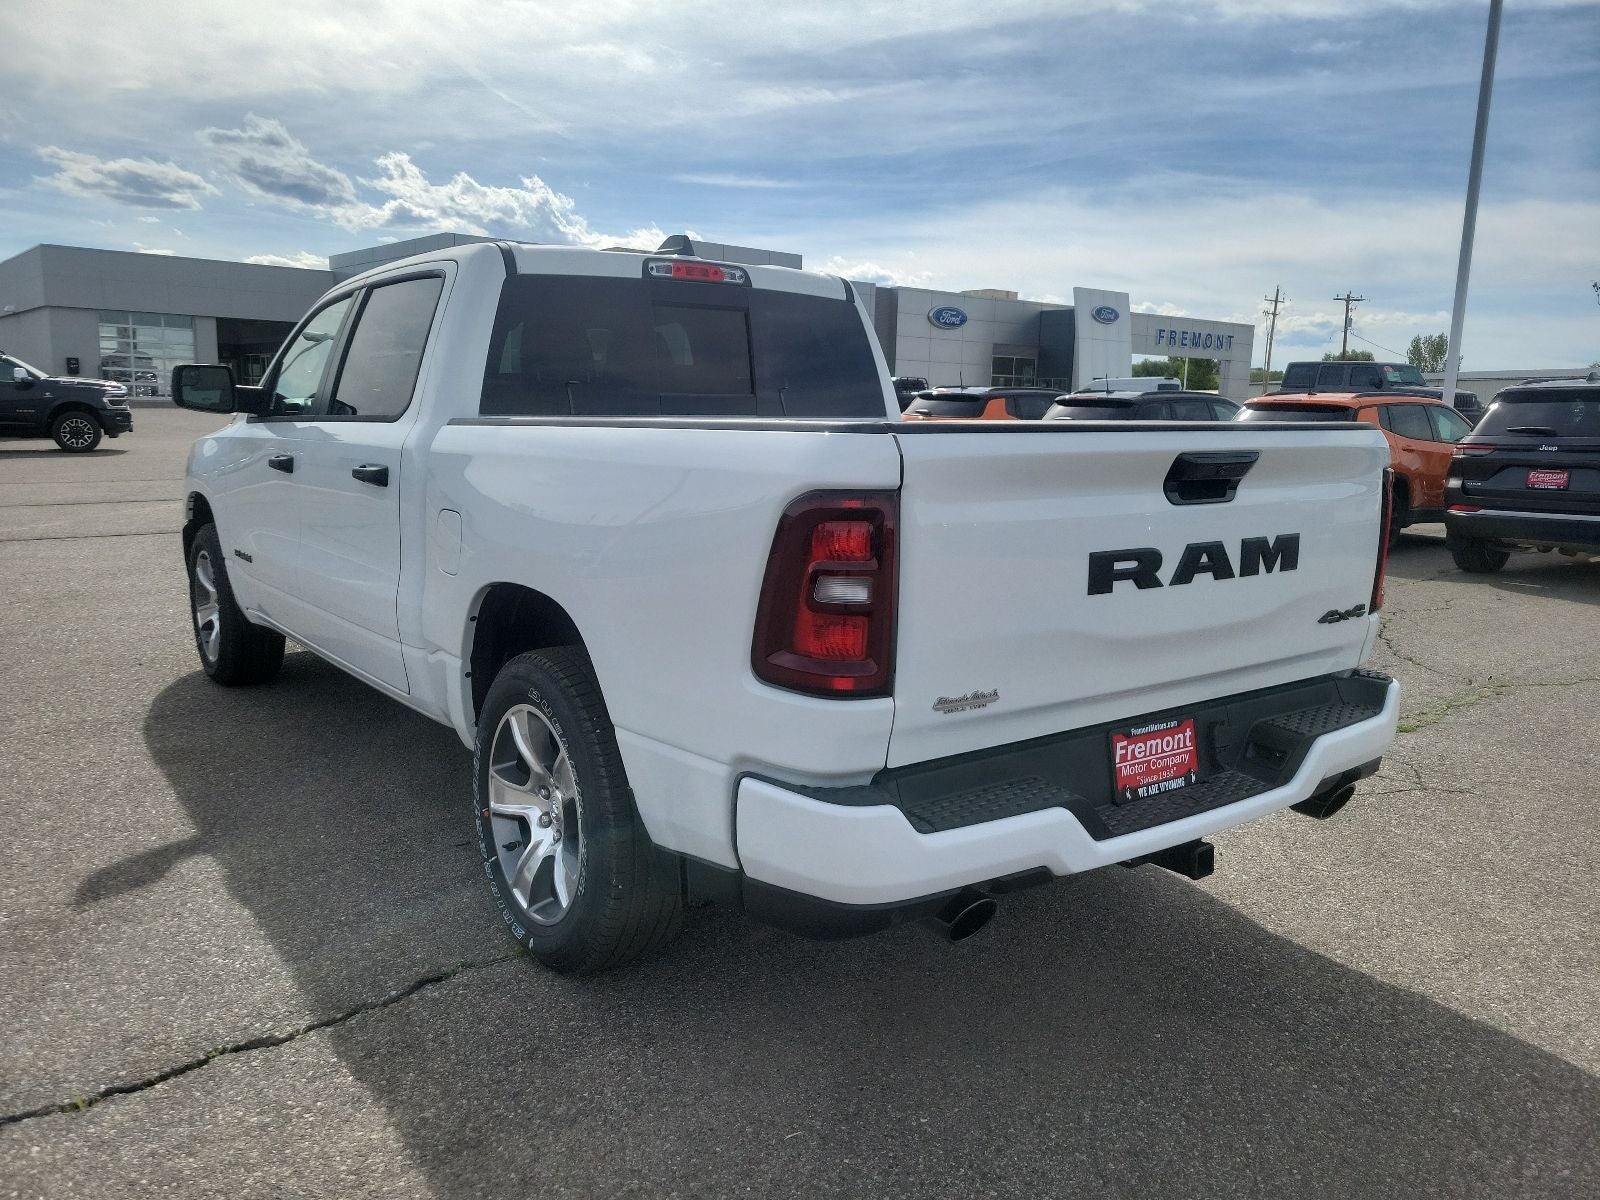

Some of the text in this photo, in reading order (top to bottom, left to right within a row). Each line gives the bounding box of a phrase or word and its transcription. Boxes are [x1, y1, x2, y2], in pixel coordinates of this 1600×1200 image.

[1157, 328, 1234, 350] FREMONT
[1539, 444, 1558, 452] Jeep
[1529, 471, 1568, 479] Fremont
[1087, 532, 1301, 596] RAM
[1115, 727, 1192, 764] Fremont
[1121, 752, 1190, 777] Motor Company
[1138, 786, 1148, 798] WE
[1148, 783, 1160, 795] ARE
